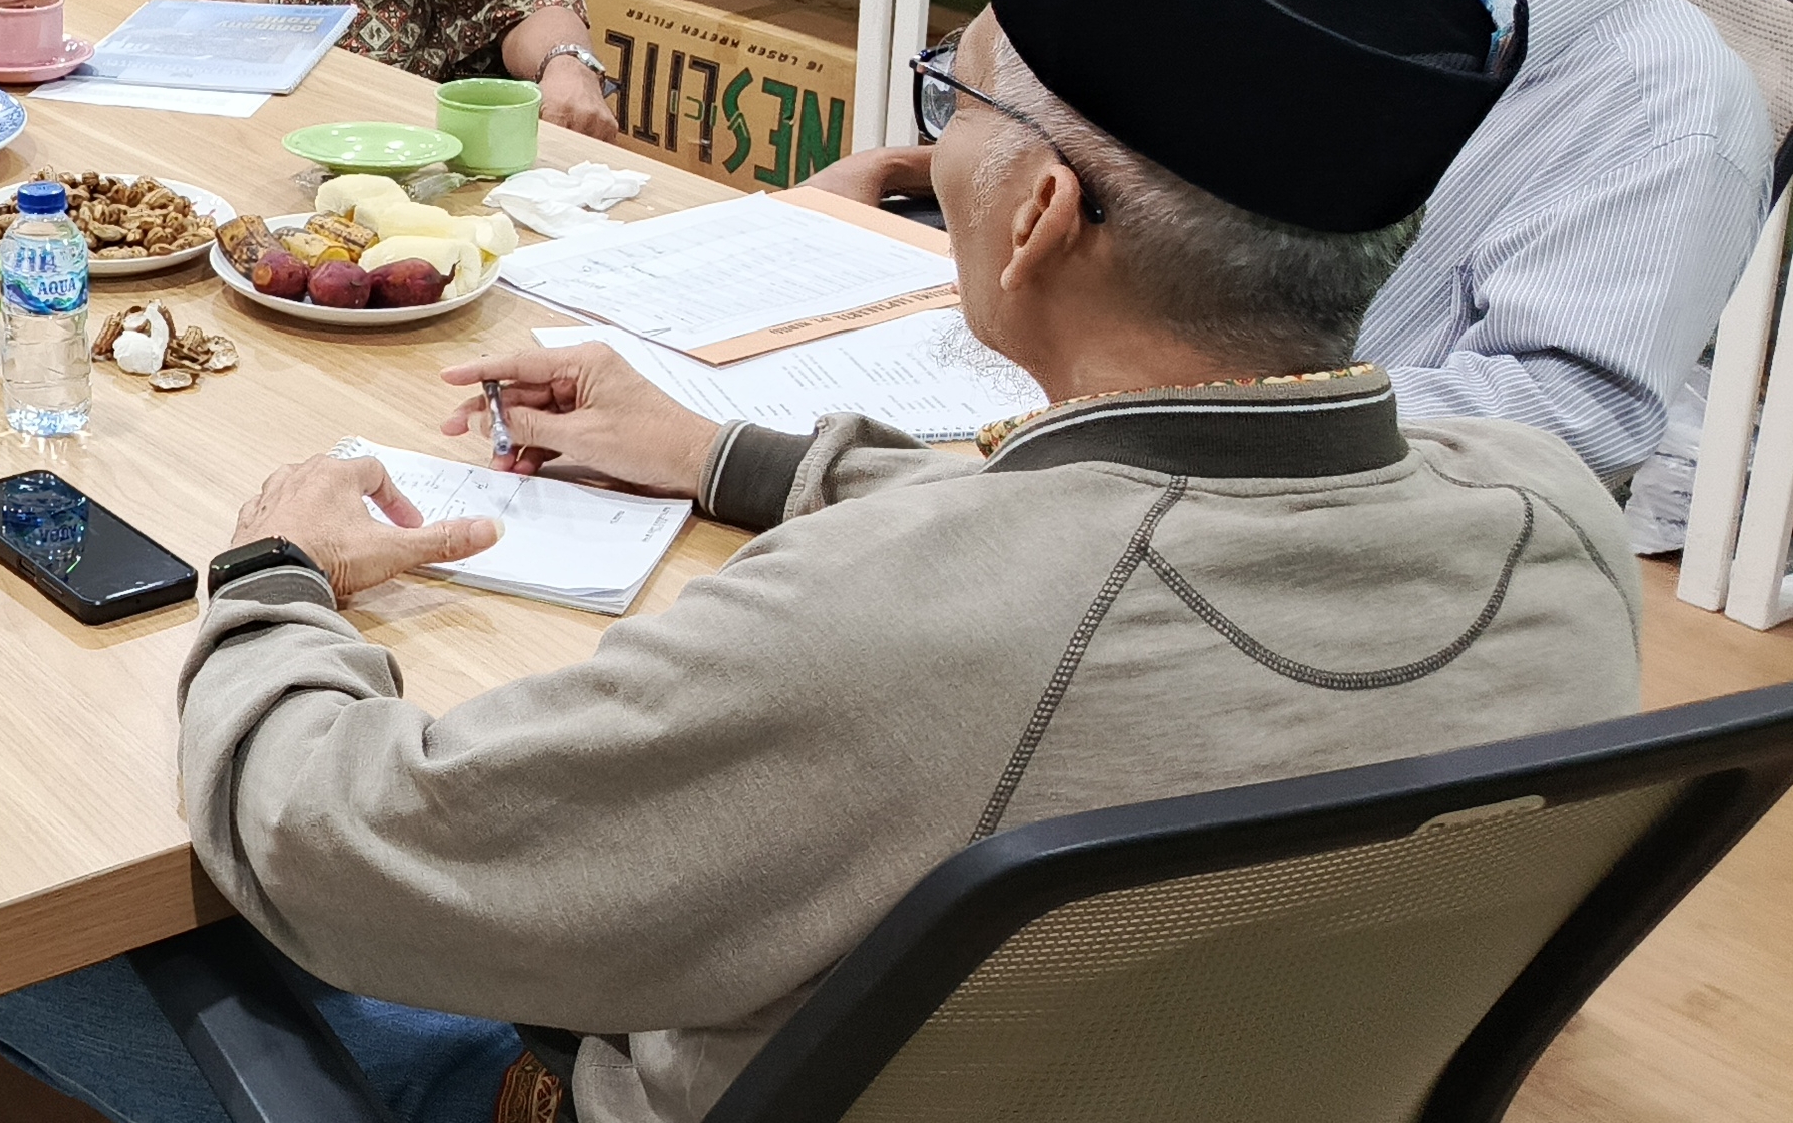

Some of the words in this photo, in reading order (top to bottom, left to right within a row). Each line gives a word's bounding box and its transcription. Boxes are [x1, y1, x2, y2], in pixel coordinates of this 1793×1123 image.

[625, 7, 675, 30] FILTER
[682, 25, 740, 50] KRETEK
[746, 44, 800, 66] LASER
[38, 278, 76, 296] AQUA
